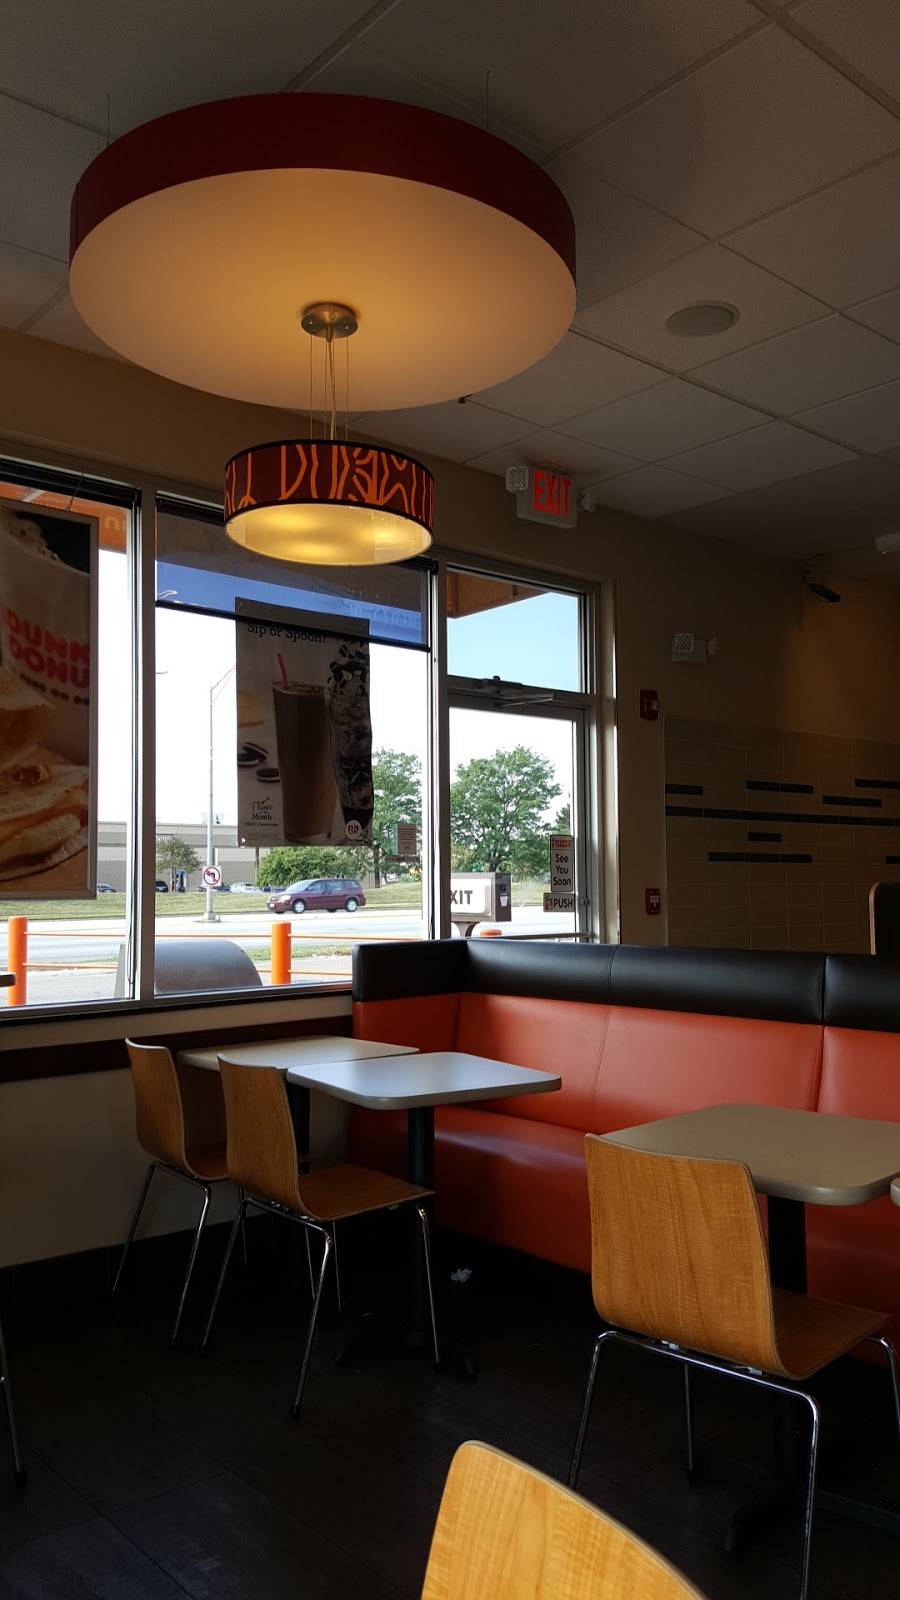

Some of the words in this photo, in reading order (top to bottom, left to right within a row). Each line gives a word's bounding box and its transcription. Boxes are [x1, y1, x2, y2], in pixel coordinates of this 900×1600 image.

[534, 470, 573, 517] EXIT
[247, 622, 266, 637] Sip
[269, 627, 282, 637] or
[555, 853, 569, 863] See
[555, 865, 569, 875] You
[553, 877, 572, 886] Soon
[553, 897, 573, 909] PUSH
